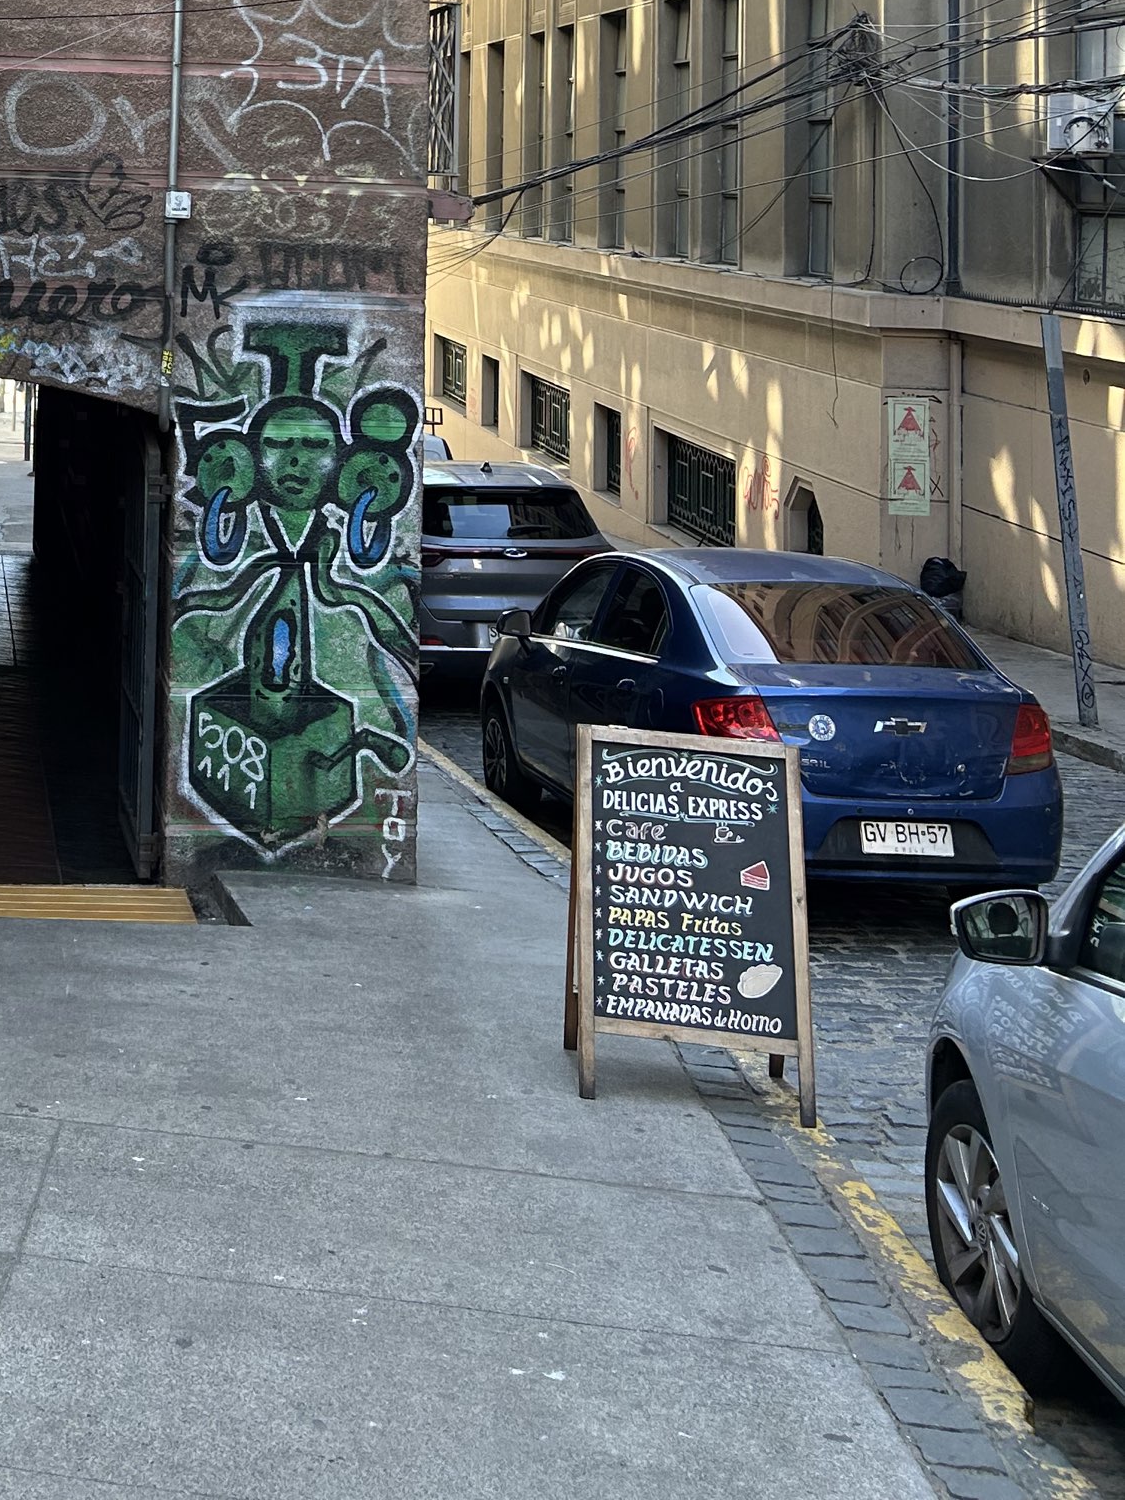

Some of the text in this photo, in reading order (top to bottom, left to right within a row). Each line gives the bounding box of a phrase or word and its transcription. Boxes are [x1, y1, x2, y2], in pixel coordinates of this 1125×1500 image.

[197, 711, 268, 782] 508
[602, 757, 779, 801] Bienvenidos
[670, 781, 685, 793] a
[603, 790, 763, 820] DELICIAS EXPRESS
[606, 819, 669, 841] Café
[608, 863, 694, 888] JUGOS
[609, 884, 753, 917] SANDWICH
[608, 906, 742, 936] PAPAS Fritas
[609, 952, 724, 981] GALLETAS
[612, 973, 732, 1005] PASTELES
[606, 995, 782, 1034] EMPANADAS de Horno
